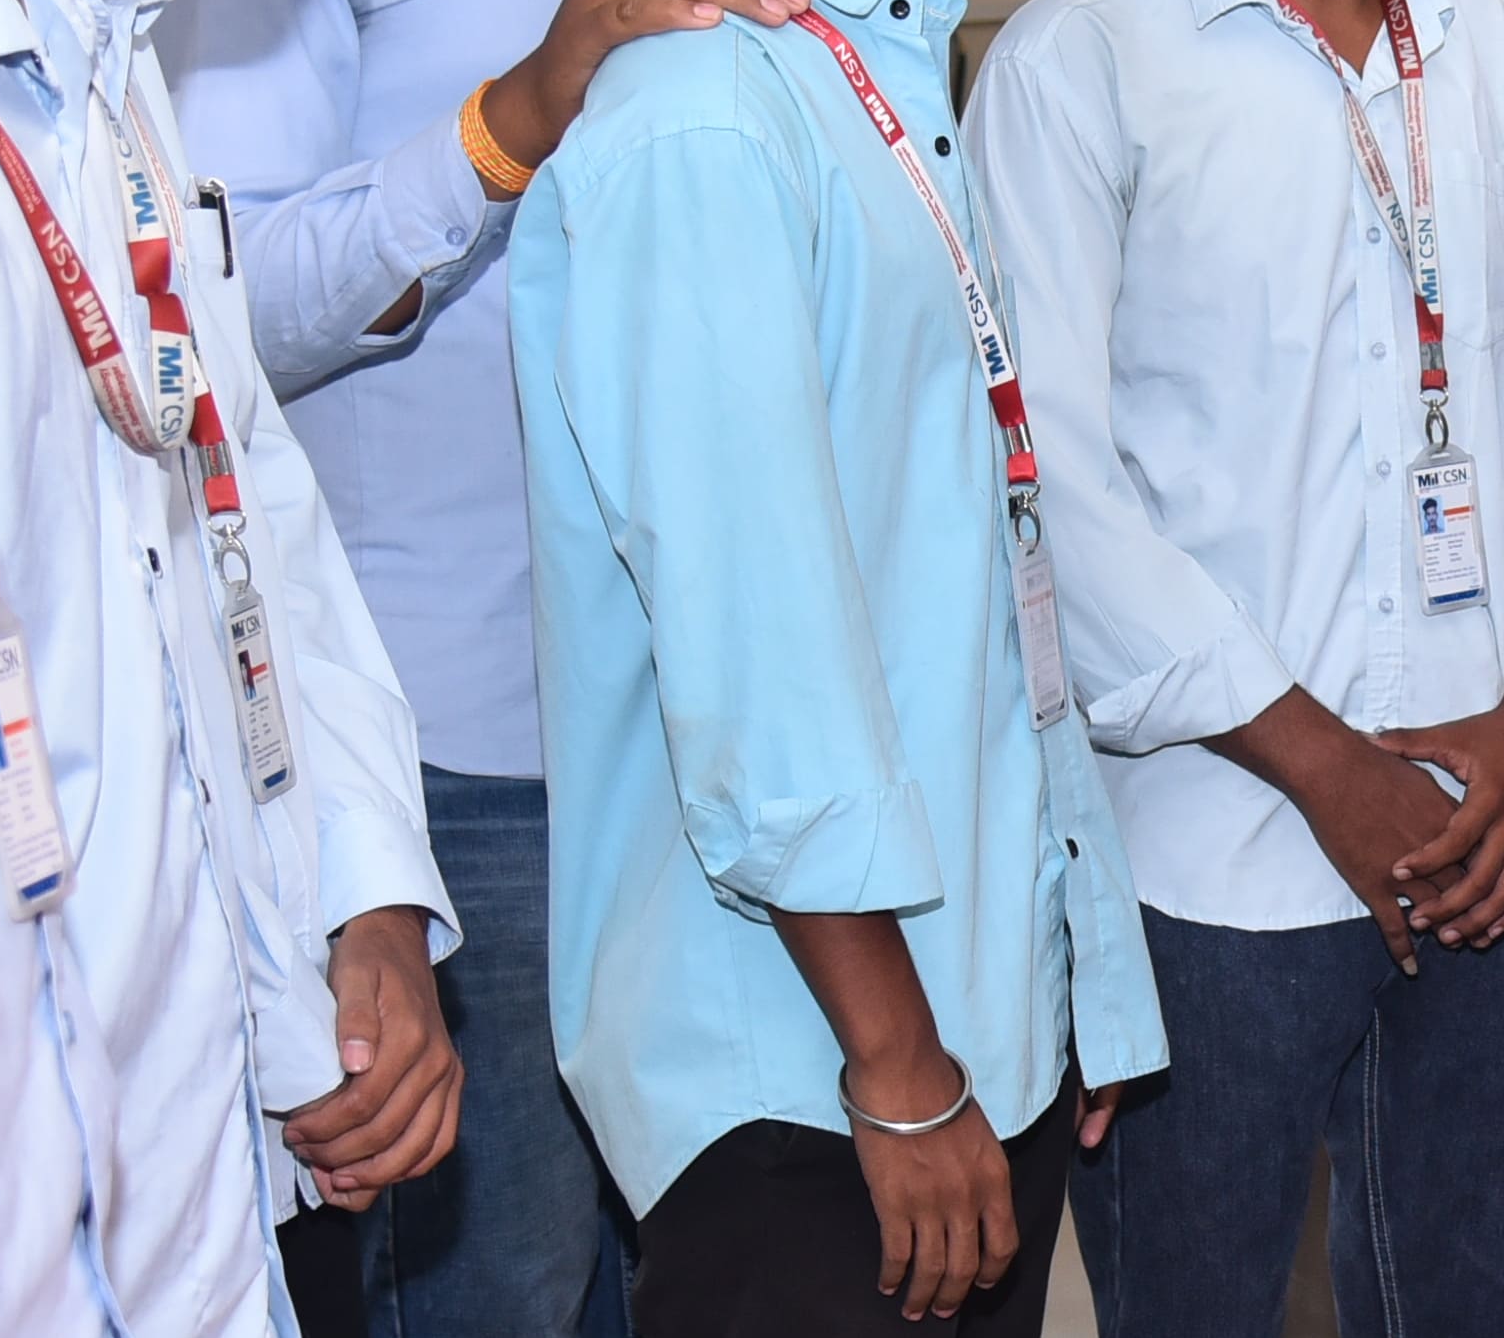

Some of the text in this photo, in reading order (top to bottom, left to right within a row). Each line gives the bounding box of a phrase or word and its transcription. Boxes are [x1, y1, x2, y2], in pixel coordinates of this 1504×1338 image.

[833, 40, 865, 88] CSN
[40, 220, 81, 284] CSN
[1418, 216, 1434, 259] CSN
[965, 281, 988, 328] CSN
[1443, 468, 1467, 483] CSN
